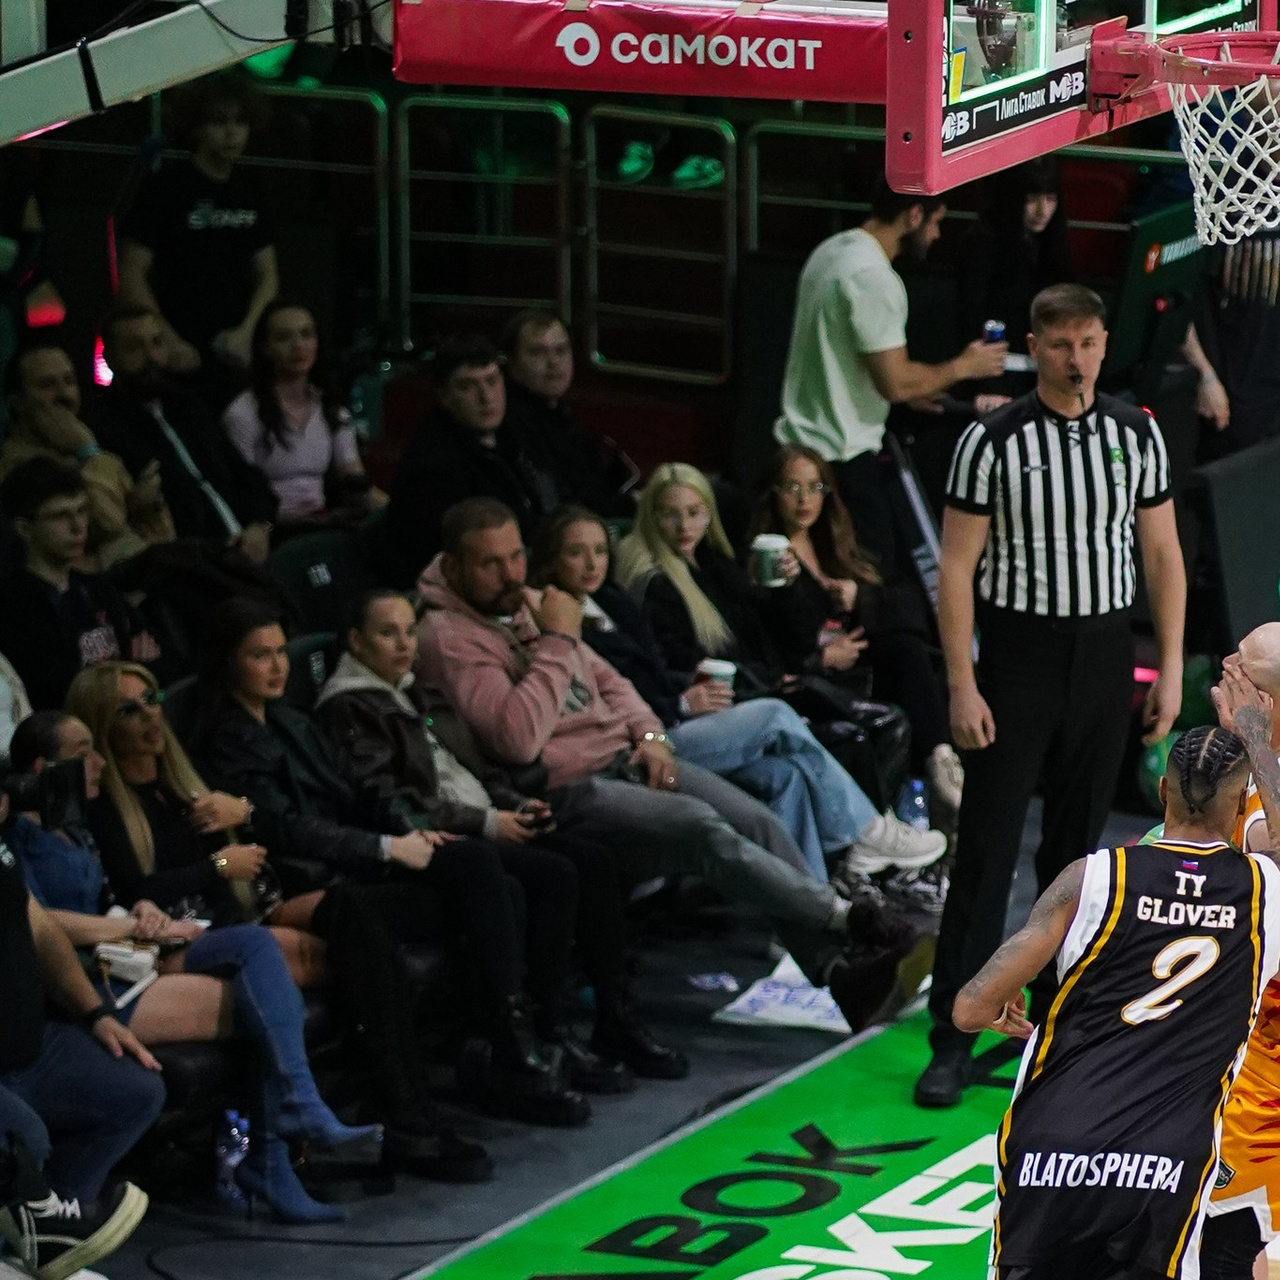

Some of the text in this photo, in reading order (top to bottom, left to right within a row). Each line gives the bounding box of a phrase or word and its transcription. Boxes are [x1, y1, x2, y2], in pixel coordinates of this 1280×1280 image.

[1174, 870, 1207, 898] TY
[1136, 896, 1237, 929] GLOVER
[1121, 936, 1221, 1026] 2
[1018, 1151, 1185, 1194] BLATOSPHERA
